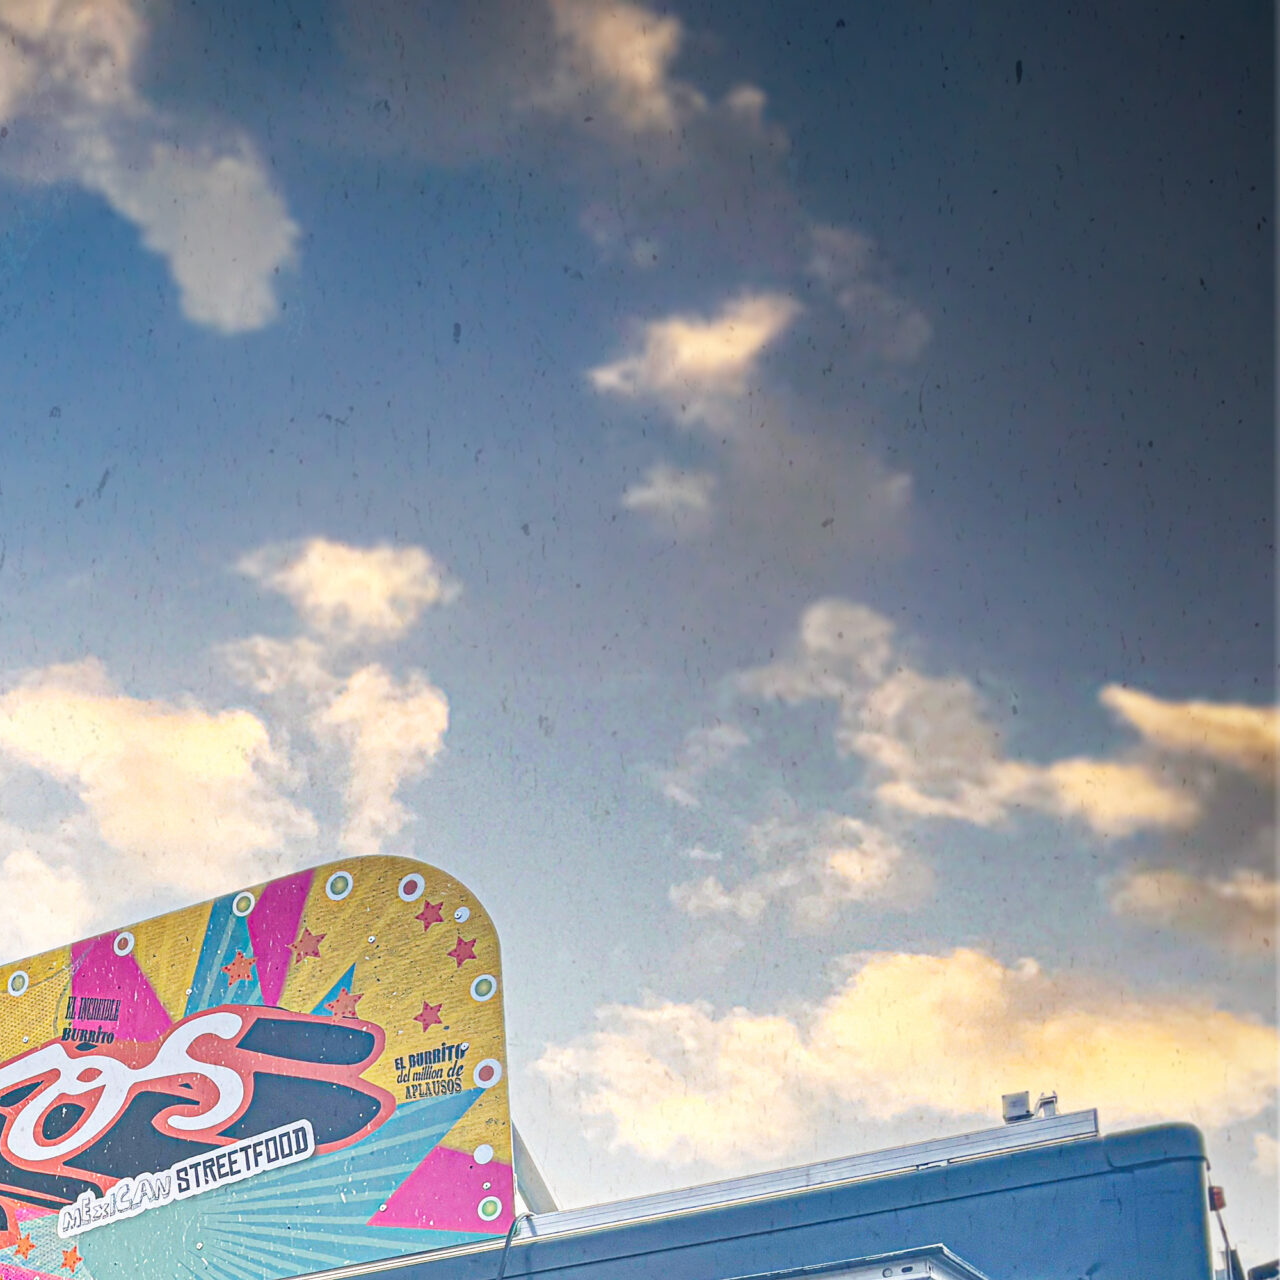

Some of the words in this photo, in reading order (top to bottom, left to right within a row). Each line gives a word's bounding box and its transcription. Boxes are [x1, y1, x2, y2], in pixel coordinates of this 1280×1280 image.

[395, 1057, 406, 1071] EL
[409, 1042, 469, 1068] BURRITO
[397, 1068, 410, 1084] del
[413, 1066, 443, 1082] million
[447, 1060, 464, 1078] de
[405, 1078, 462, 1099] APLAUSOS
[176, 1126, 309, 1193] STREETFOOD
